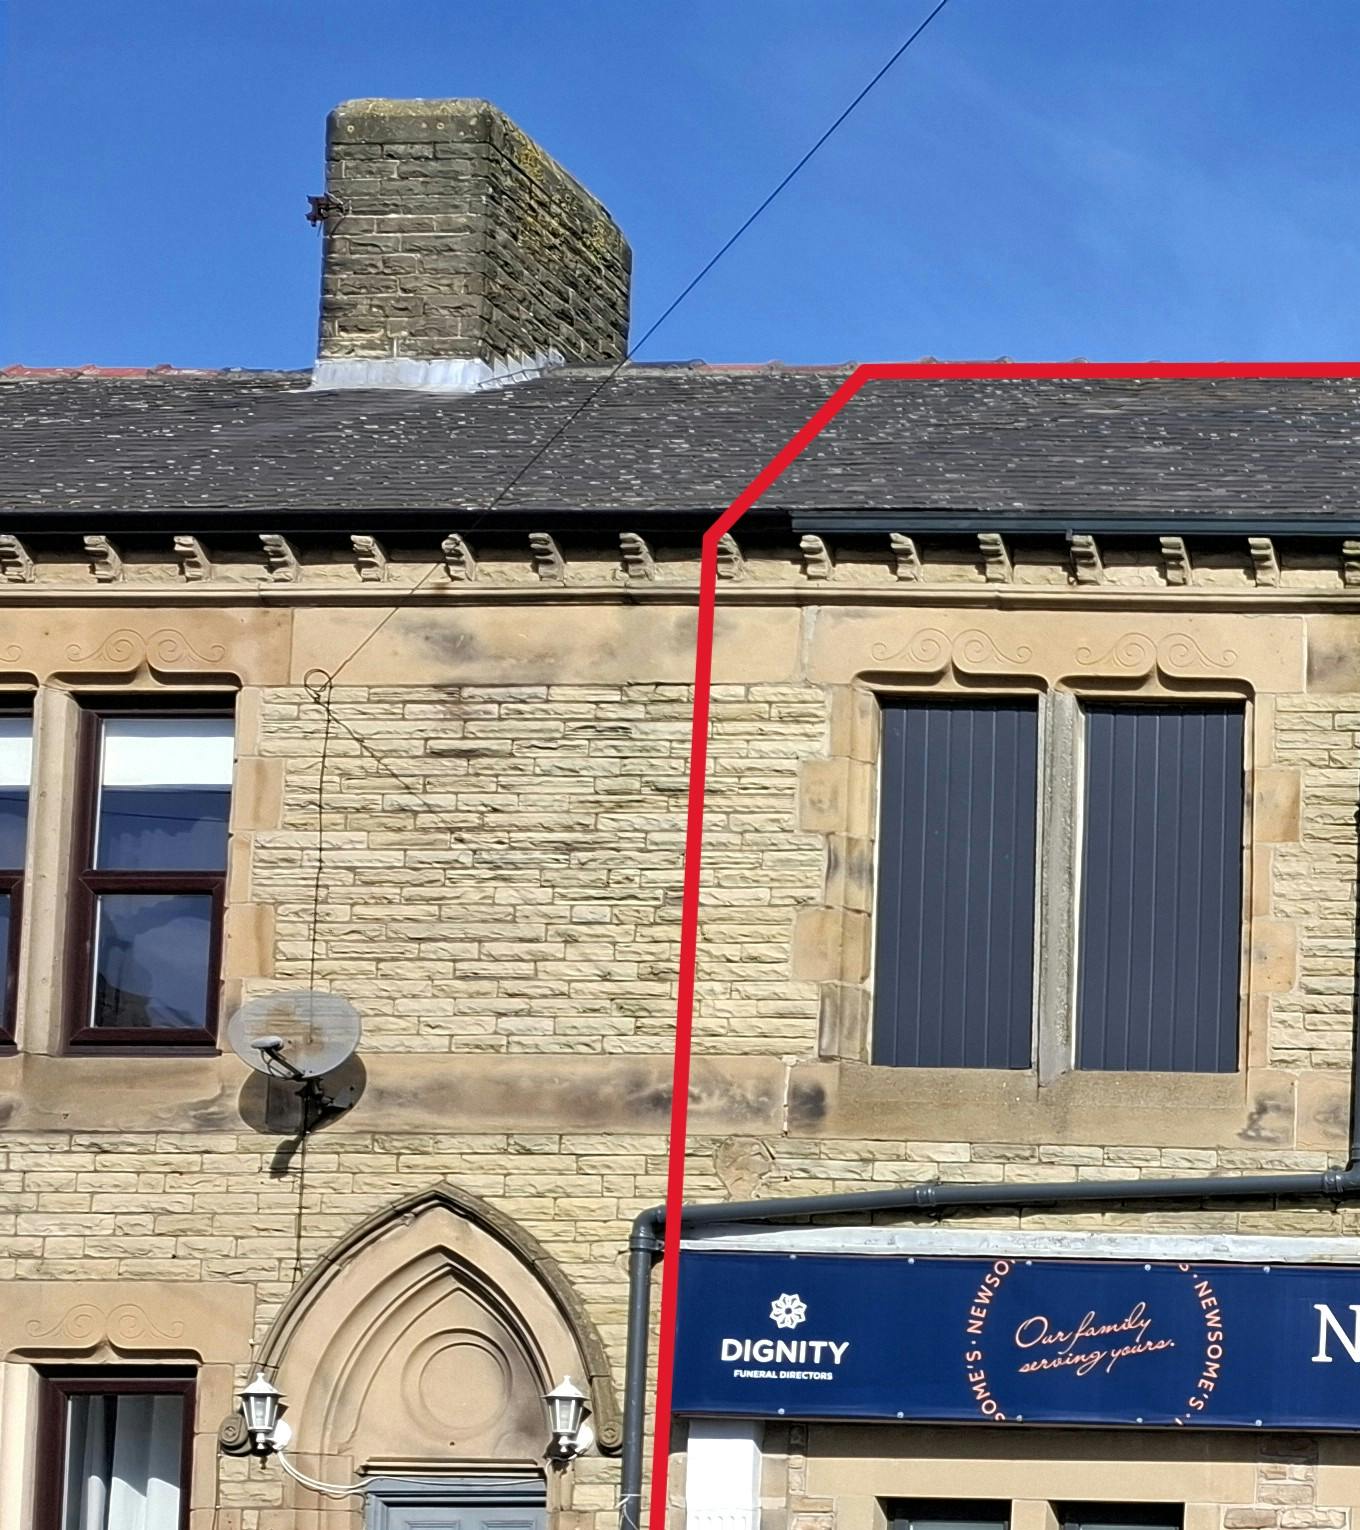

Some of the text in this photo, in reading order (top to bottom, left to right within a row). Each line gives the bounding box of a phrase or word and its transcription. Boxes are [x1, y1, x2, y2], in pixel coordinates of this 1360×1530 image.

[1015, 1301, 1151, 1355] Our family
[1189, 1280, 1223, 1411] NEWSOME'S
[721, 1338, 850, 1365] DIGNITY
[1018, 1338, 1175, 1376] serving yours.
[733, 1369, 833, 1381] FUNERAL DIRECTORS
